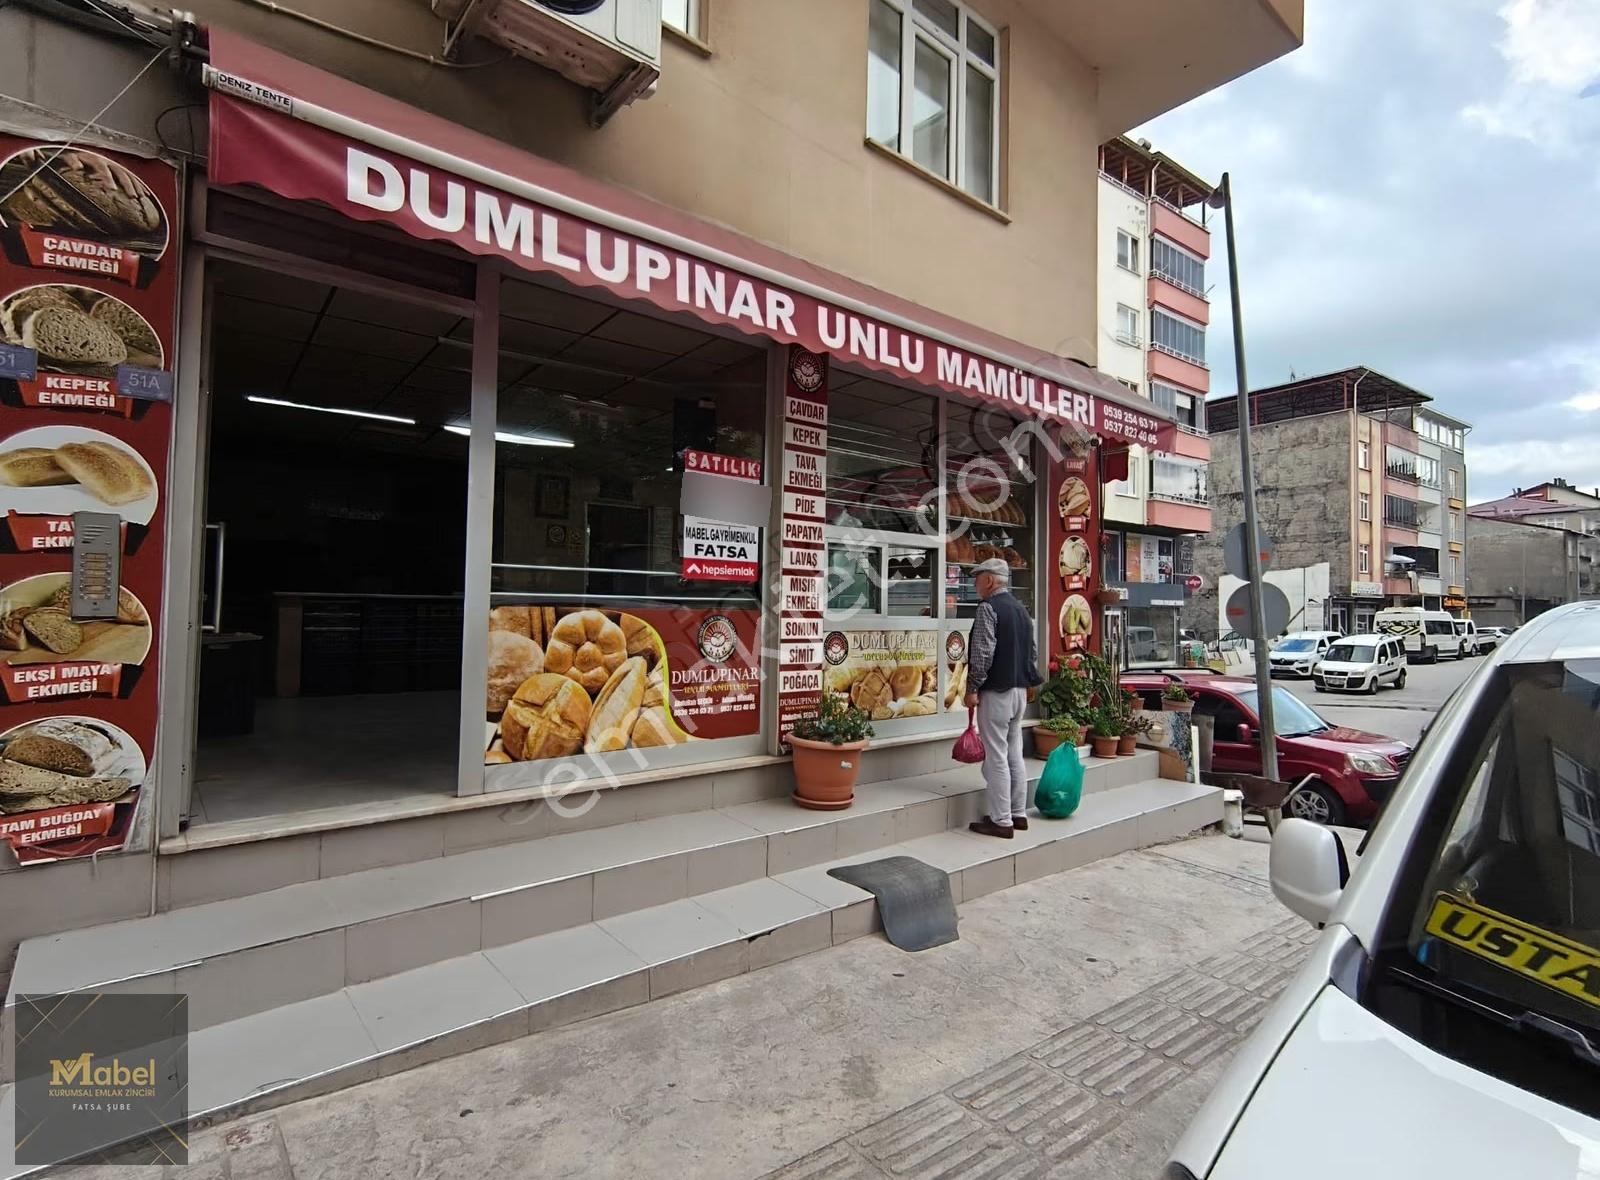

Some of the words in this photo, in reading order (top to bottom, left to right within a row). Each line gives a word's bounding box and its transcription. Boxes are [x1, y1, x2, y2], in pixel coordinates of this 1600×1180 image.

[256, 86, 290, 106] TENTE
[43, 237, 122, 260] ÇAVDAR
[42, 253, 119, 275] EKMEĞİ
[346, 146, 798, 337] DUMLUPINAR
[817, 305, 925, 374] UNLU
[937, 345, 1095, 427] MAMÜLLERİ
[46, 377, 110, 392] KEPEK
[129, 373, 160, 389] 51A
[38, 392, 115, 408] EKMEĞİ
[789, 400, 824, 421] ÇAVDAR
[1103, 404, 1123, 420] 0539
[1124, 412, 1138, 426] 254
[1139, 416, 1148, 428] 63
[1149, 420, 1158, 432] 71
[792, 427, 821, 446] KEPEK
[1104, 418, 1123, 434] 0537
[1124, 425, 1138, 438] 823
[795, 453, 817, 471] TAVA
[788, 471, 822, 489] EKMEĞİ
[795, 495, 816, 514] PİDE
[686, 526, 710, 541] MABEL
[710, 528, 756, 544] GAYRİMENKUL
[786, 523, 823, 541] PAPATYA
[694, 544, 748, 560] FATSA
[790, 551, 818, 571] LAVAŞ
[702, 564, 755, 578] hepsiemlak
[790, 578, 816, 594] MISIR
[786, 594, 820, 611] EKMEĞİ
[786, 620, 819, 637] SOMUN
[789, 644, 814, 664] SİMİT
[14, 667, 56, 684] EKŞİ
[62, 664, 113, 679] MAYA
[672, 667, 759, 684] DUMLUPINAR
[782, 672, 820, 691] POĞAÇA
[28, 678, 98, 698] EKMEĞİ
[1, 819, 34, 834] TAM
[40, 808, 100, 827] BUĞDAY
[21, 824, 82, 844] EKMEĞİ
